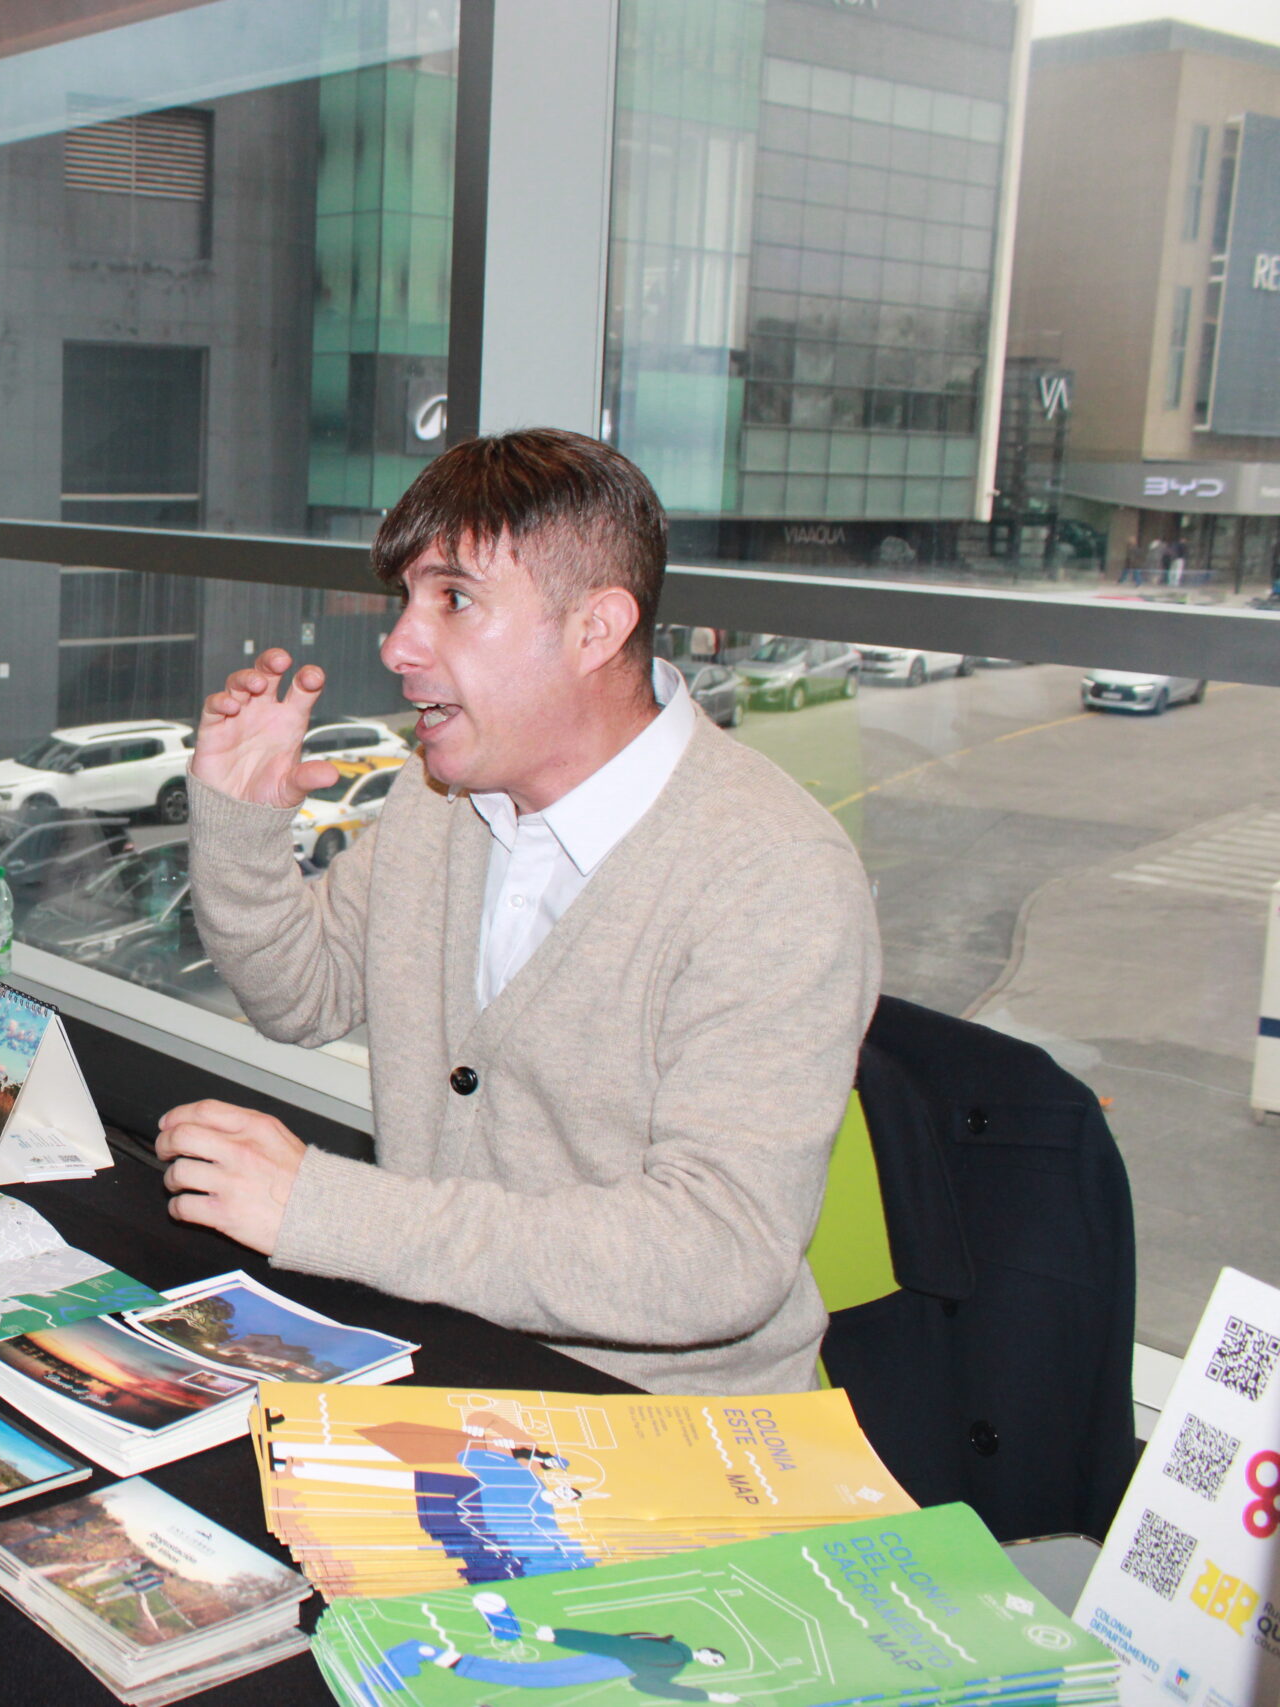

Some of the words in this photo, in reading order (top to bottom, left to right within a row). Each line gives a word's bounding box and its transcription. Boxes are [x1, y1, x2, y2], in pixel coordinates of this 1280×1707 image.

[1143, 476, 1225, 498] BYD
[723, 1408, 758, 1446] ESTE
[751, 1408, 798, 1472] COLONIA
[725, 1474, 760, 1505] MAP
[849, 1536, 891, 1577] DEL
[880, 1532, 961, 1617] COLONIA
[823, 1541, 954, 1669] SACRAMENTO
[1095, 1607, 1133, 1640] COLONIA
[868, 1633, 923, 1671] MAP
[1089, 1617, 1160, 1673] DEPARTAMENTO
